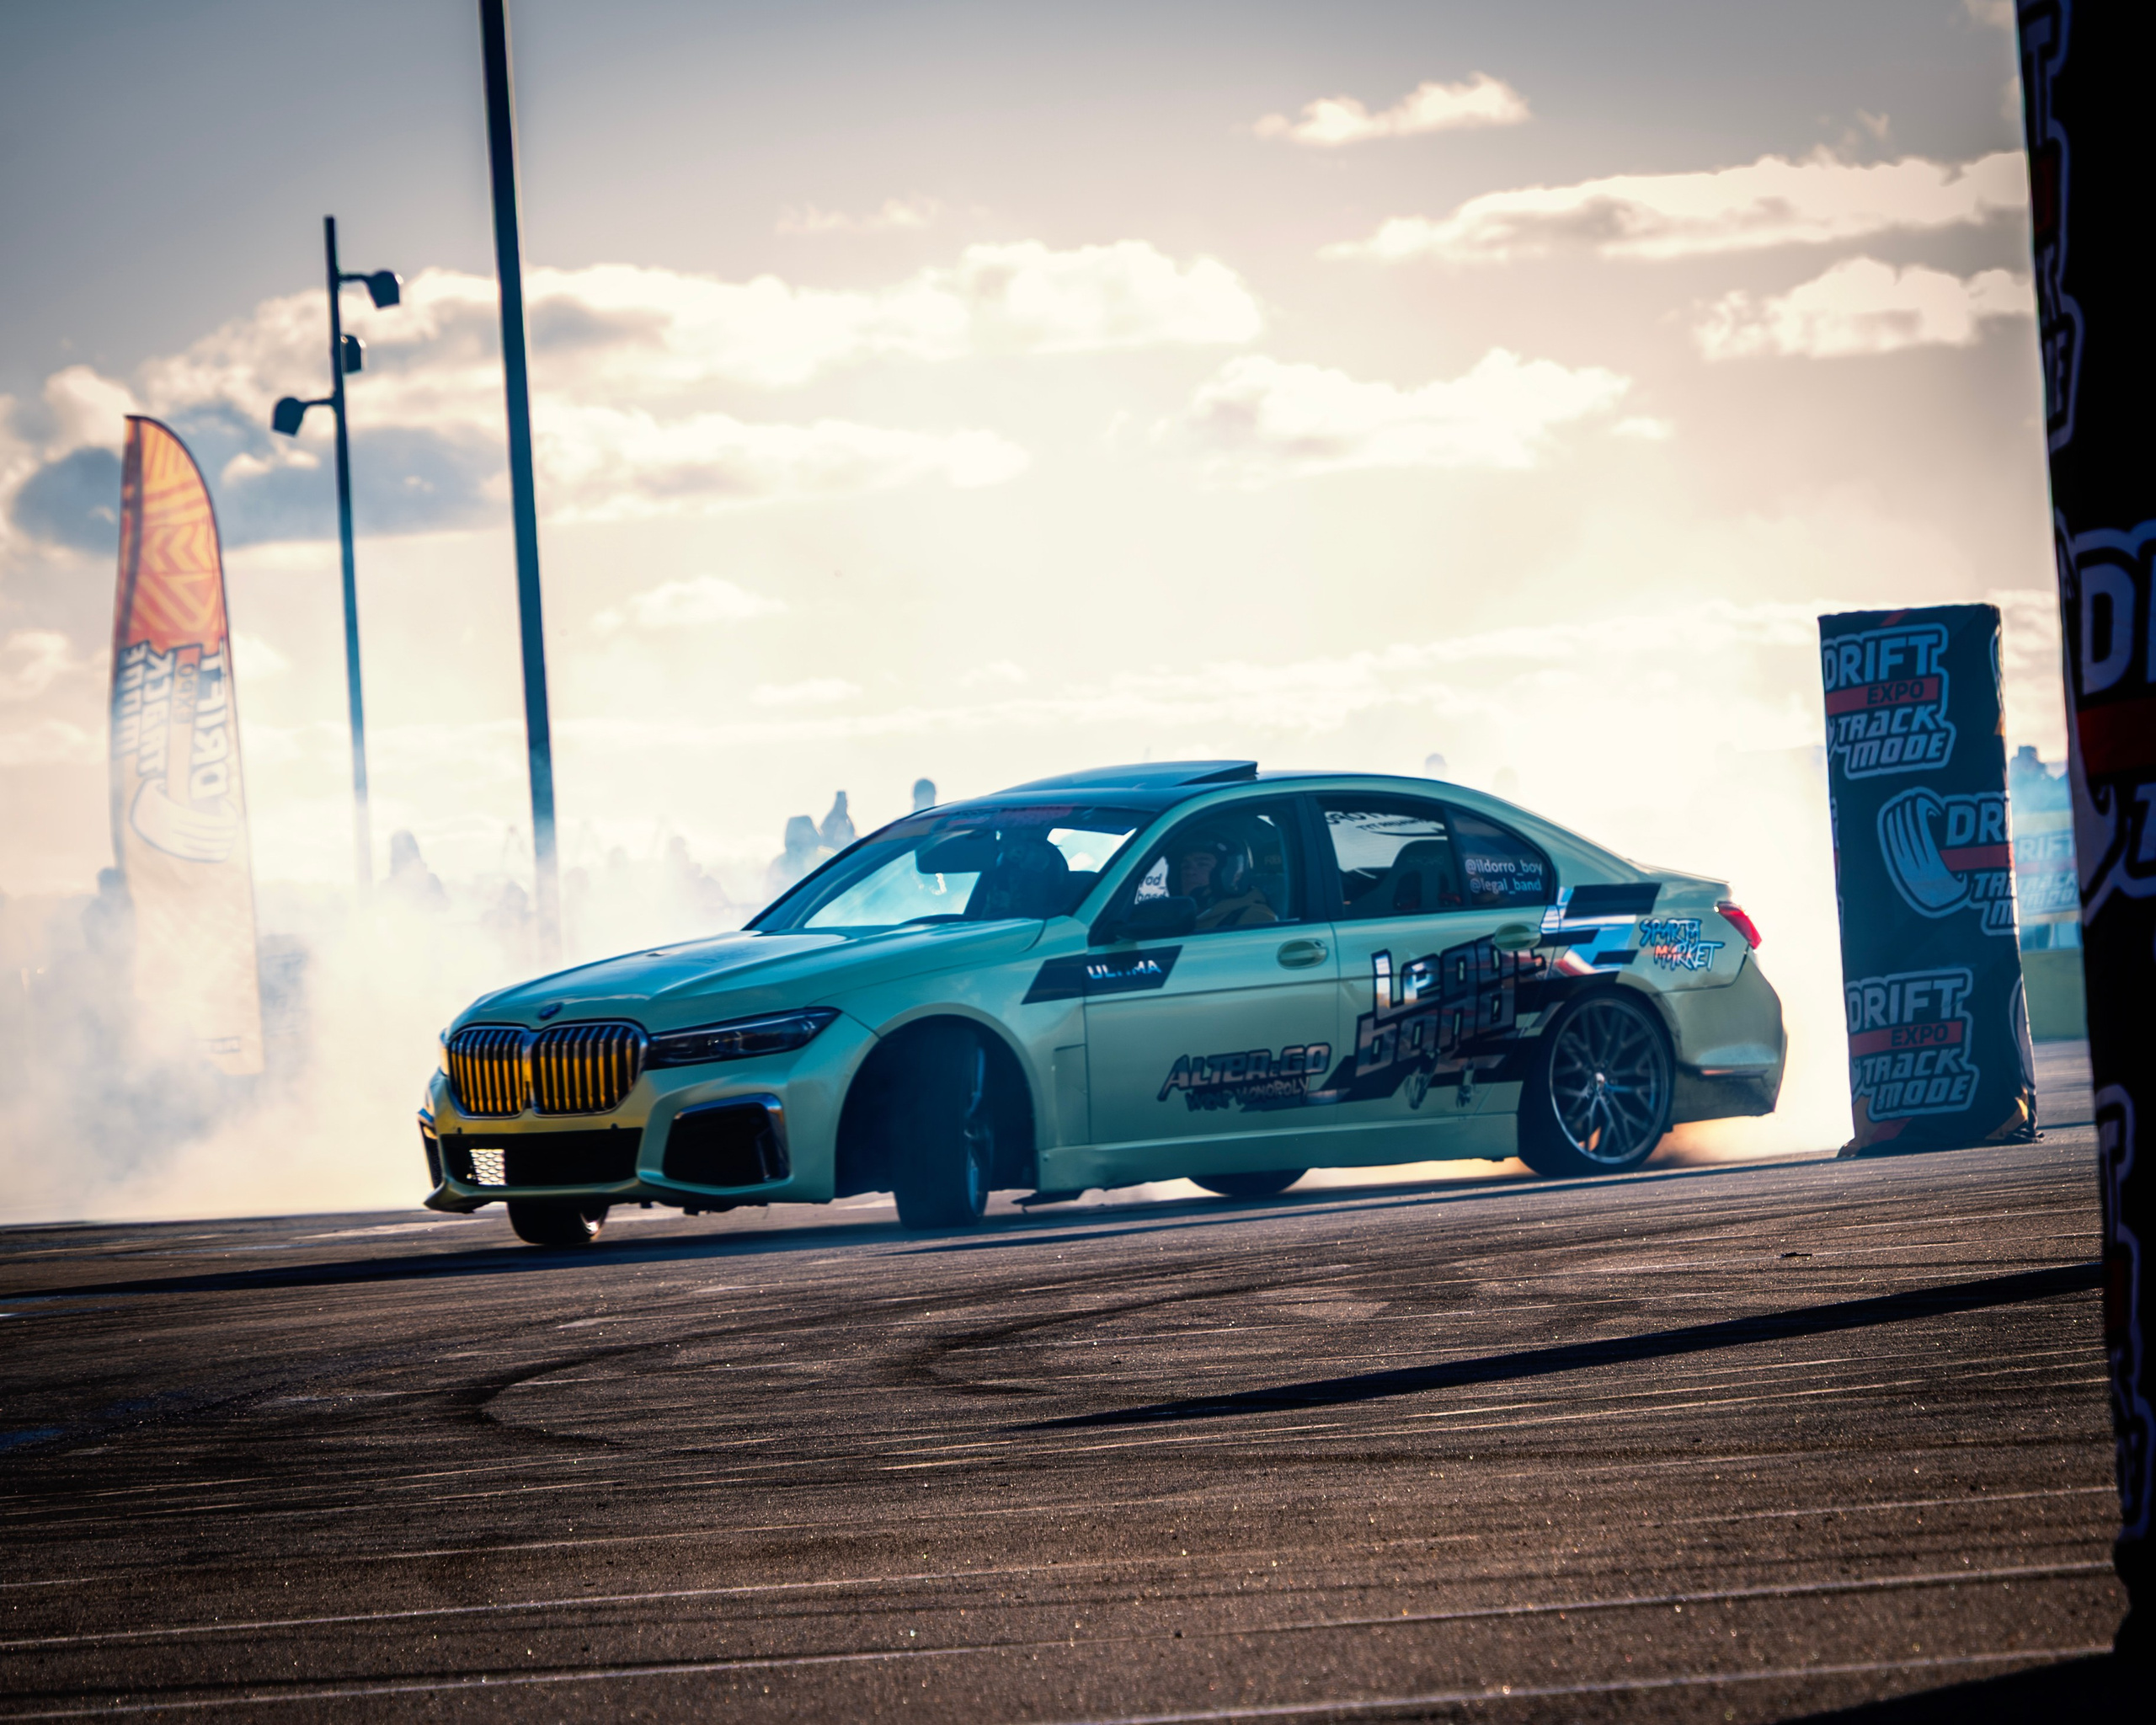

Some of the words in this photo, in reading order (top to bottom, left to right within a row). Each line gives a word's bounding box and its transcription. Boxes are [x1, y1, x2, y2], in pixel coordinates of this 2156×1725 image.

[1823, 635, 1940, 692] DRIFT
[1866, 681, 1925, 706] EXPO
[1838, 704, 1938, 743] TRACK
[1850, 730, 1947, 768] MODE
[1470, 878, 1543, 896] @legal_band
[1086, 959, 1163, 980] ULMA
[1654, 940, 1726, 972] MARKET
[1847, 979, 1964, 1033] DRIFT
[1891, 1023, 1949, 1048] EXPO
[1862, 1047, 1962, 1085] TRACK
[1876, 1075, 1972, 1111] MODE
